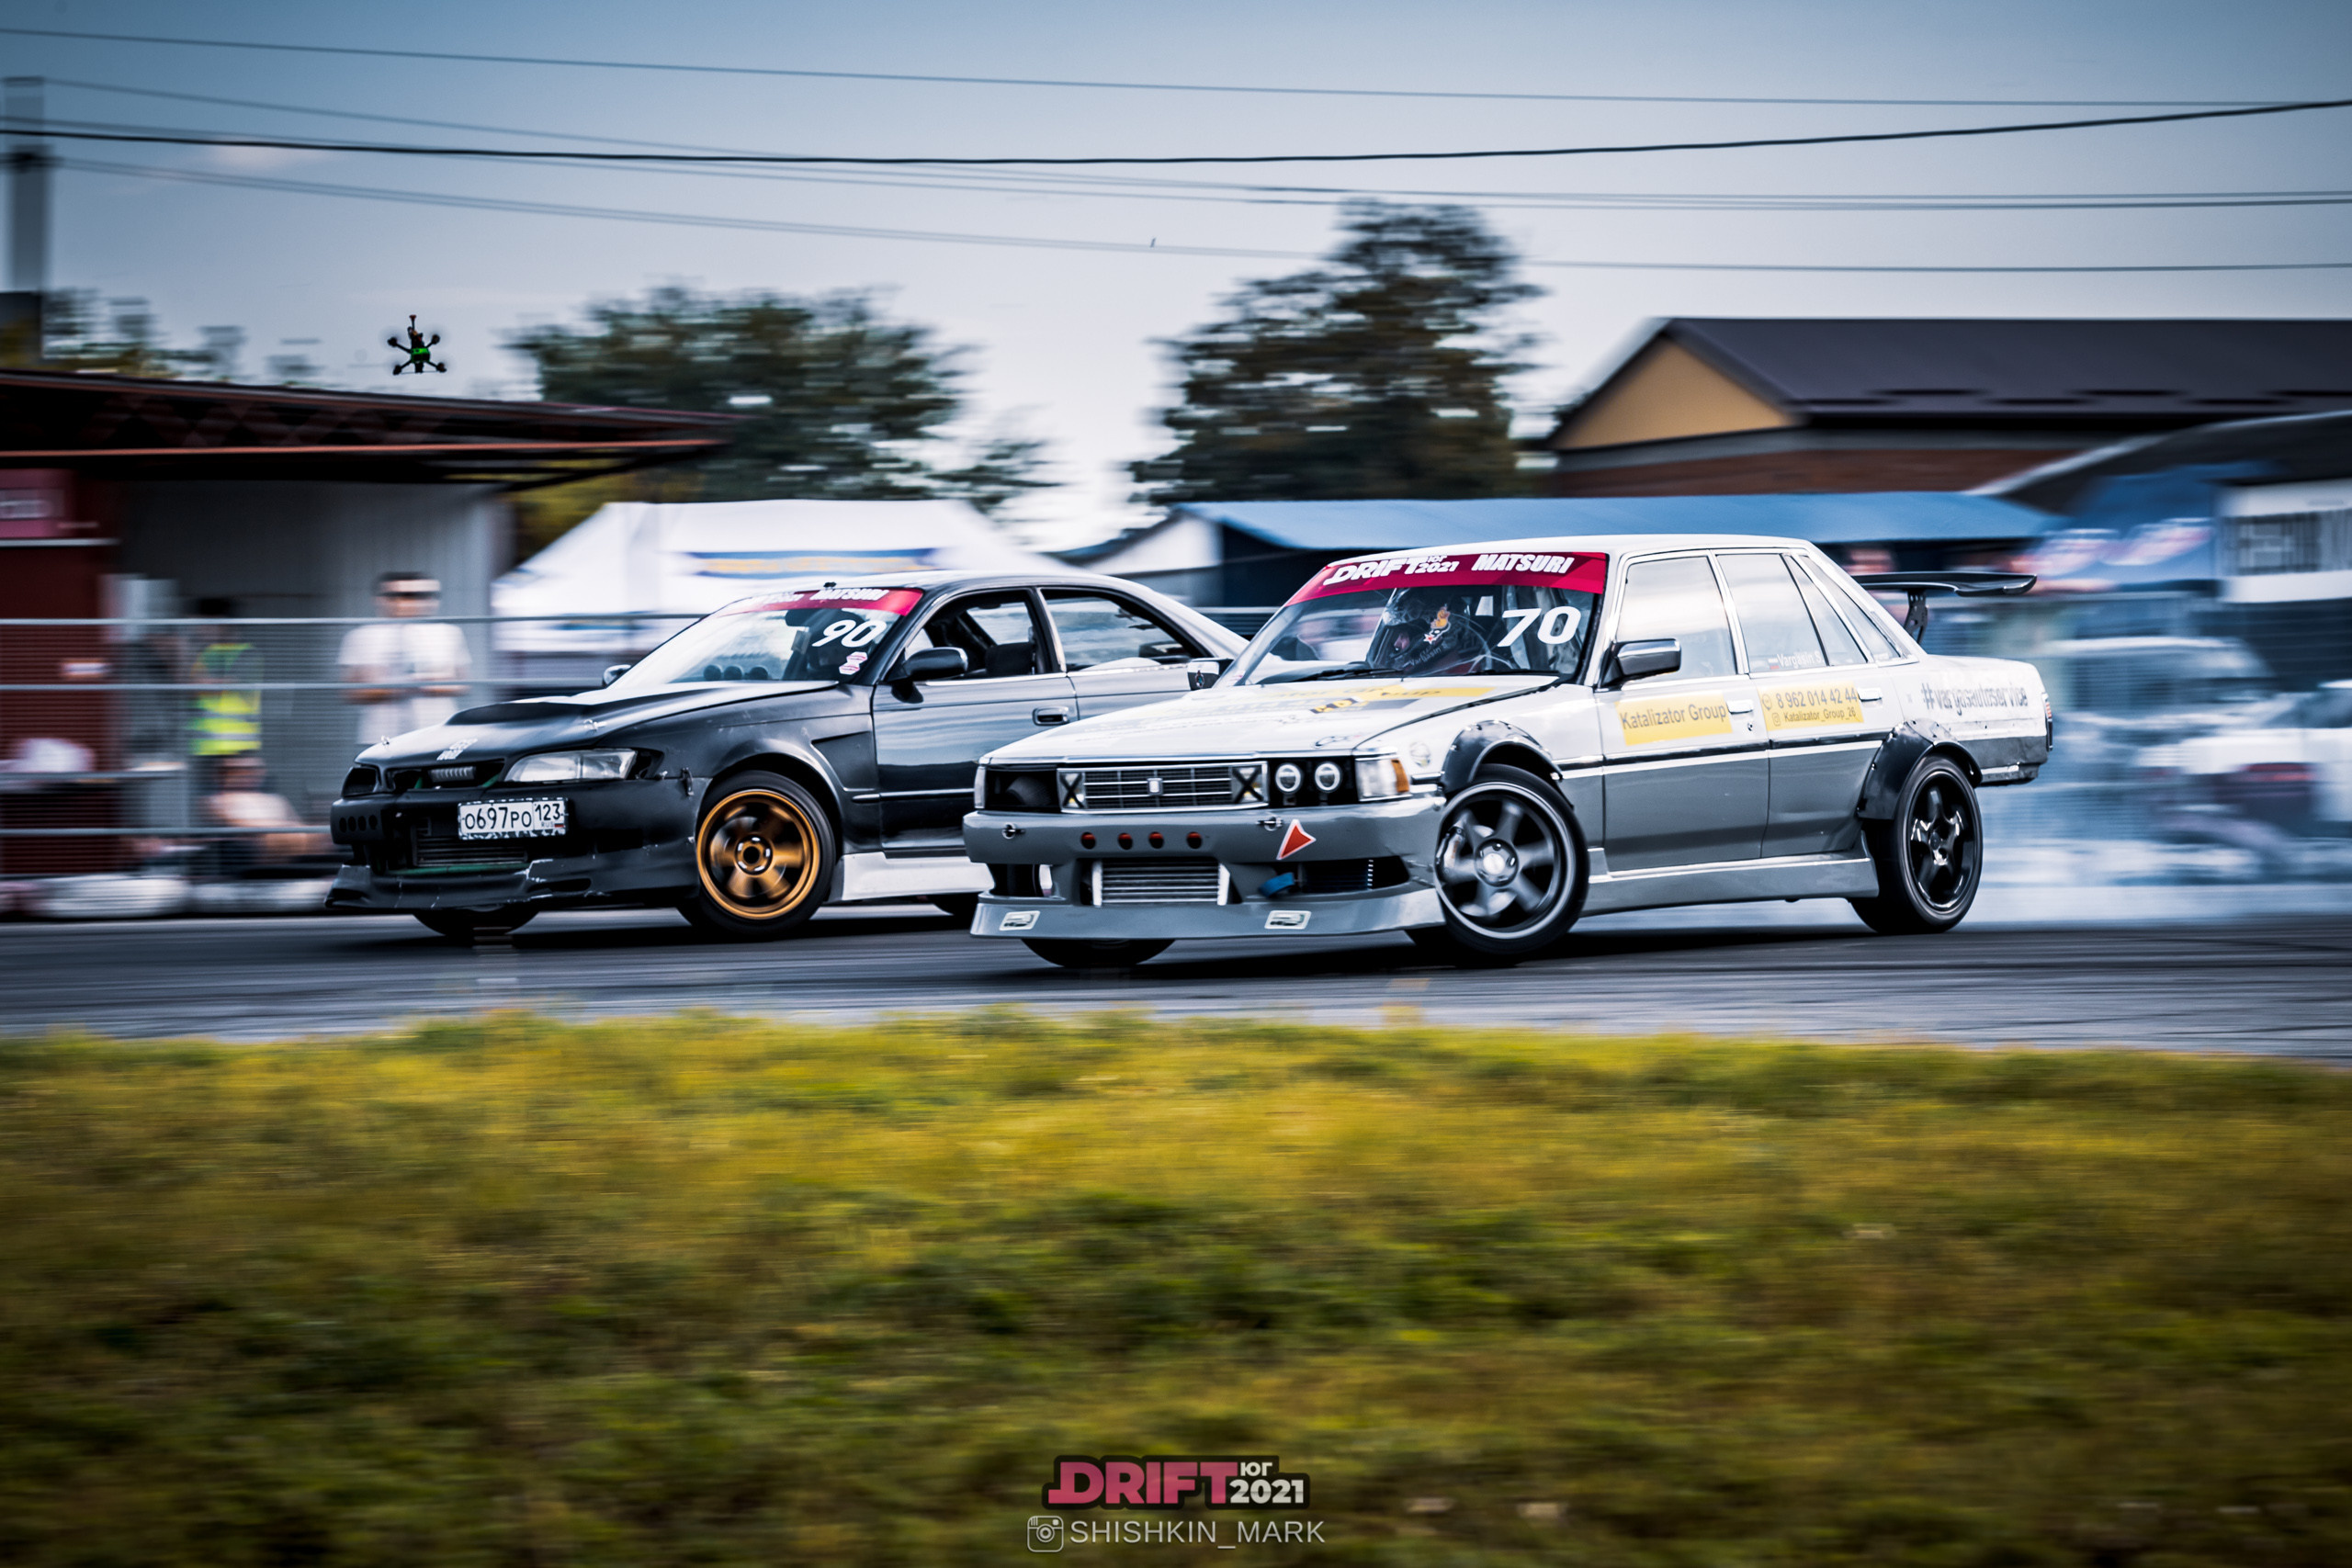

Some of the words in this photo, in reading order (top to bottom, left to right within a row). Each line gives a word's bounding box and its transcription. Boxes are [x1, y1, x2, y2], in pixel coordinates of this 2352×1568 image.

[1323, 557, 1428, 586] DRIFT
[1414, 561, 1460, 574] 2021
[1471, 554, 1575, 574] MATSURI
[812, 619, 888, 648] 90
[1497, 605, 1582, 648] 70
[1776, 693, 1784, 709] 8
[1785, 691, 1806, 708] 962
[1807, 689, 1827, 706] 014
[1829, 688, 1843, 705] 42
[1845, 687, 1858, 703] 44
[1620, 707, 1686, 729] Katalizator
[1688, 704, 1726, 723] Group
[535, 803, 561, 821] 123
